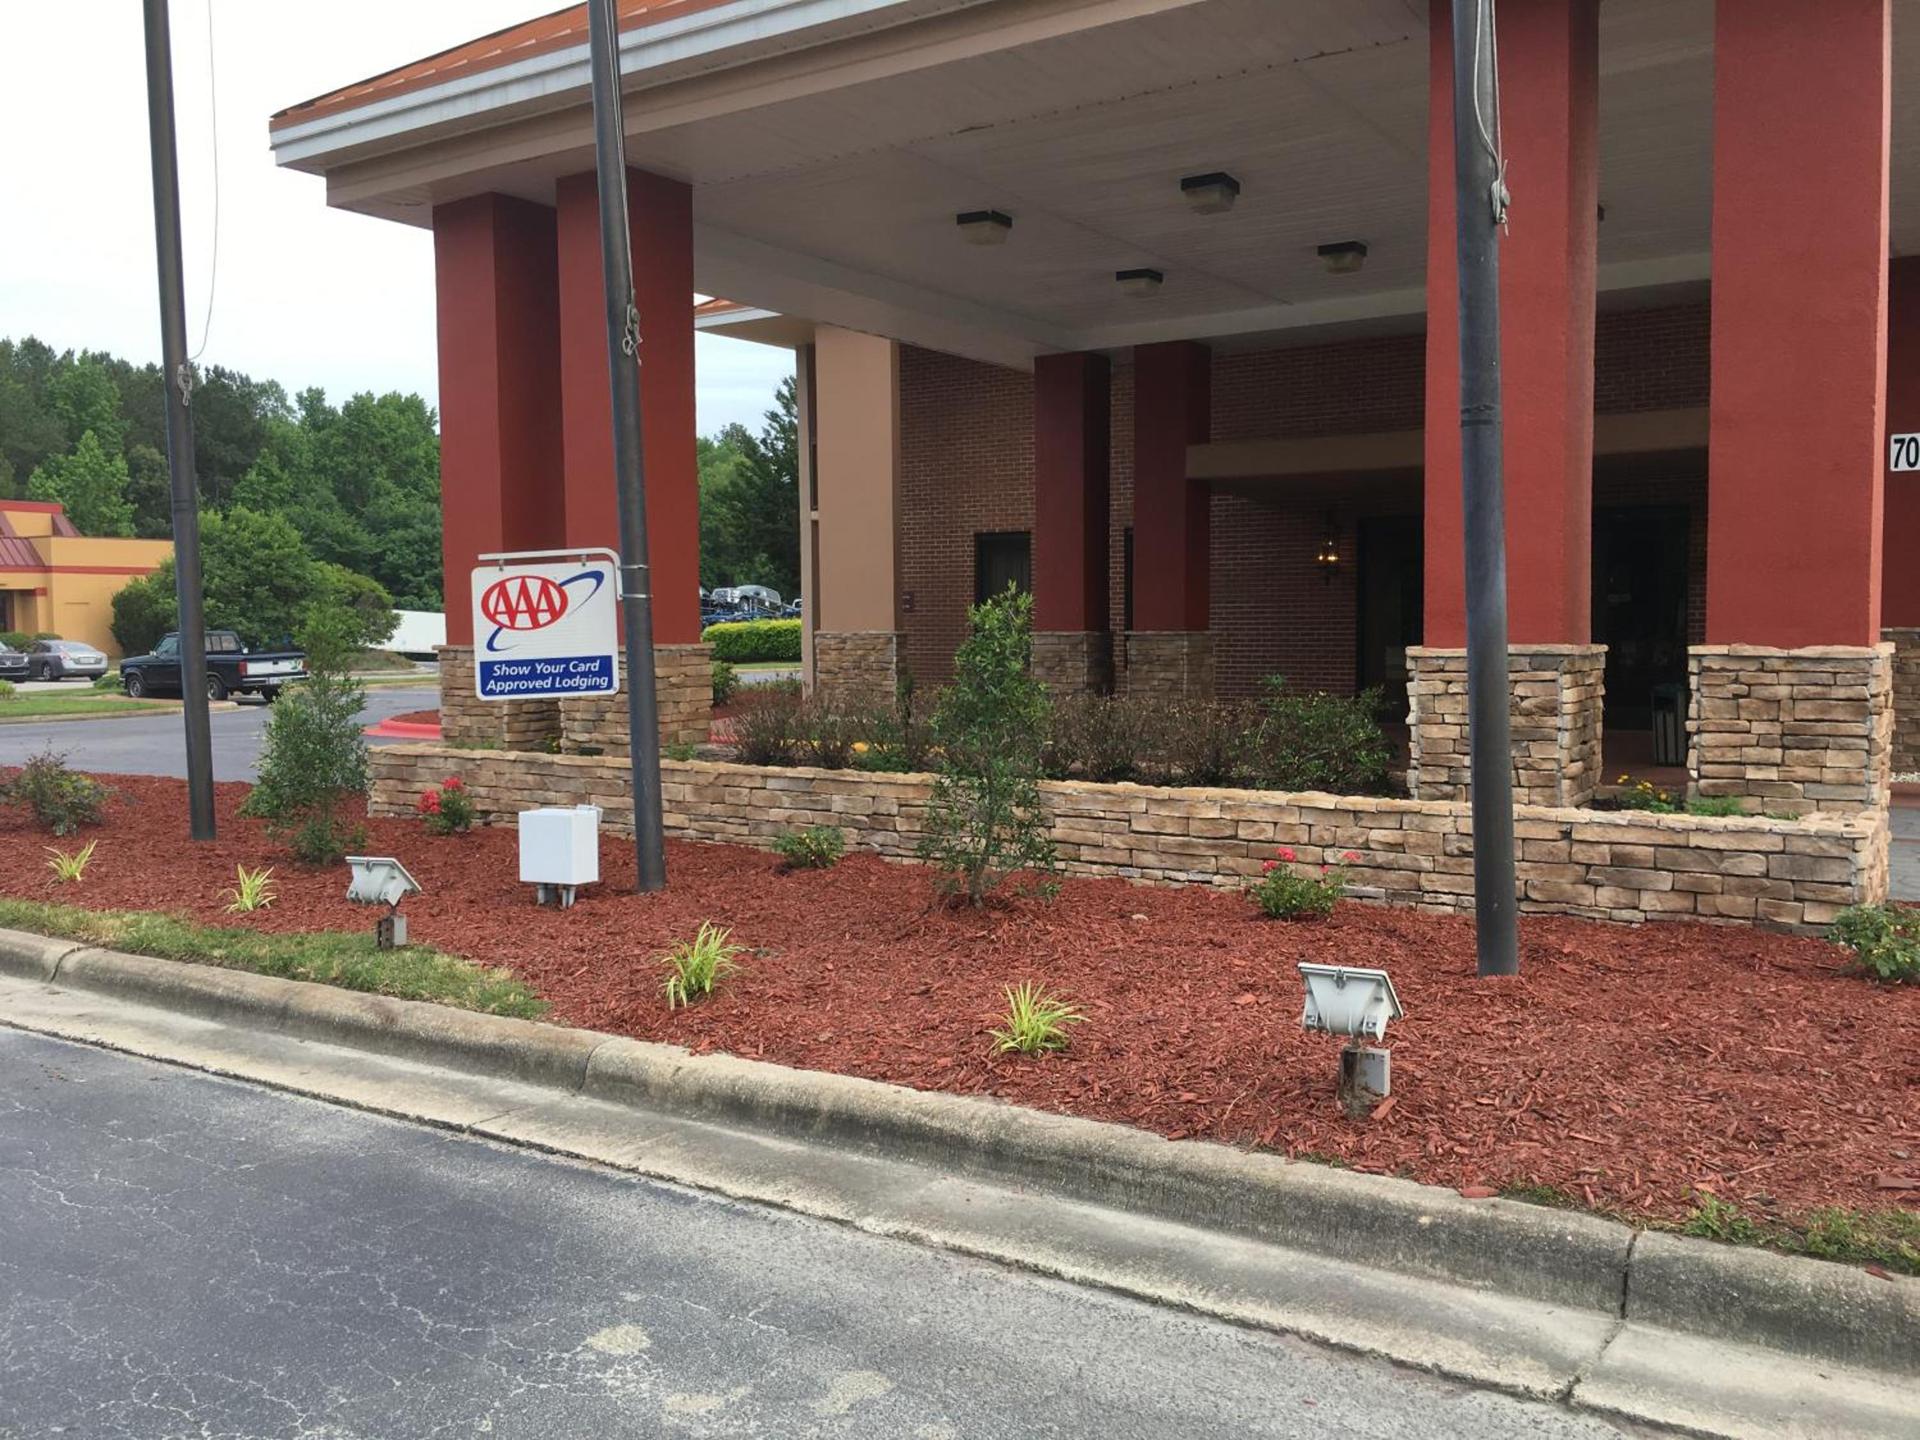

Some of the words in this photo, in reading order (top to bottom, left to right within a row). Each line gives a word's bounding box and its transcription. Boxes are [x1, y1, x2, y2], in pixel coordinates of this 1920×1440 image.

[491, 577, 560, 630] AAA
[493, 664, 531, 677] Show
[535, 662, 566, 675] Your
[569, 660, 600, 673] Card
[486, 677, 551, 693] Approved
[555, 674, 609, 689] Lodging
